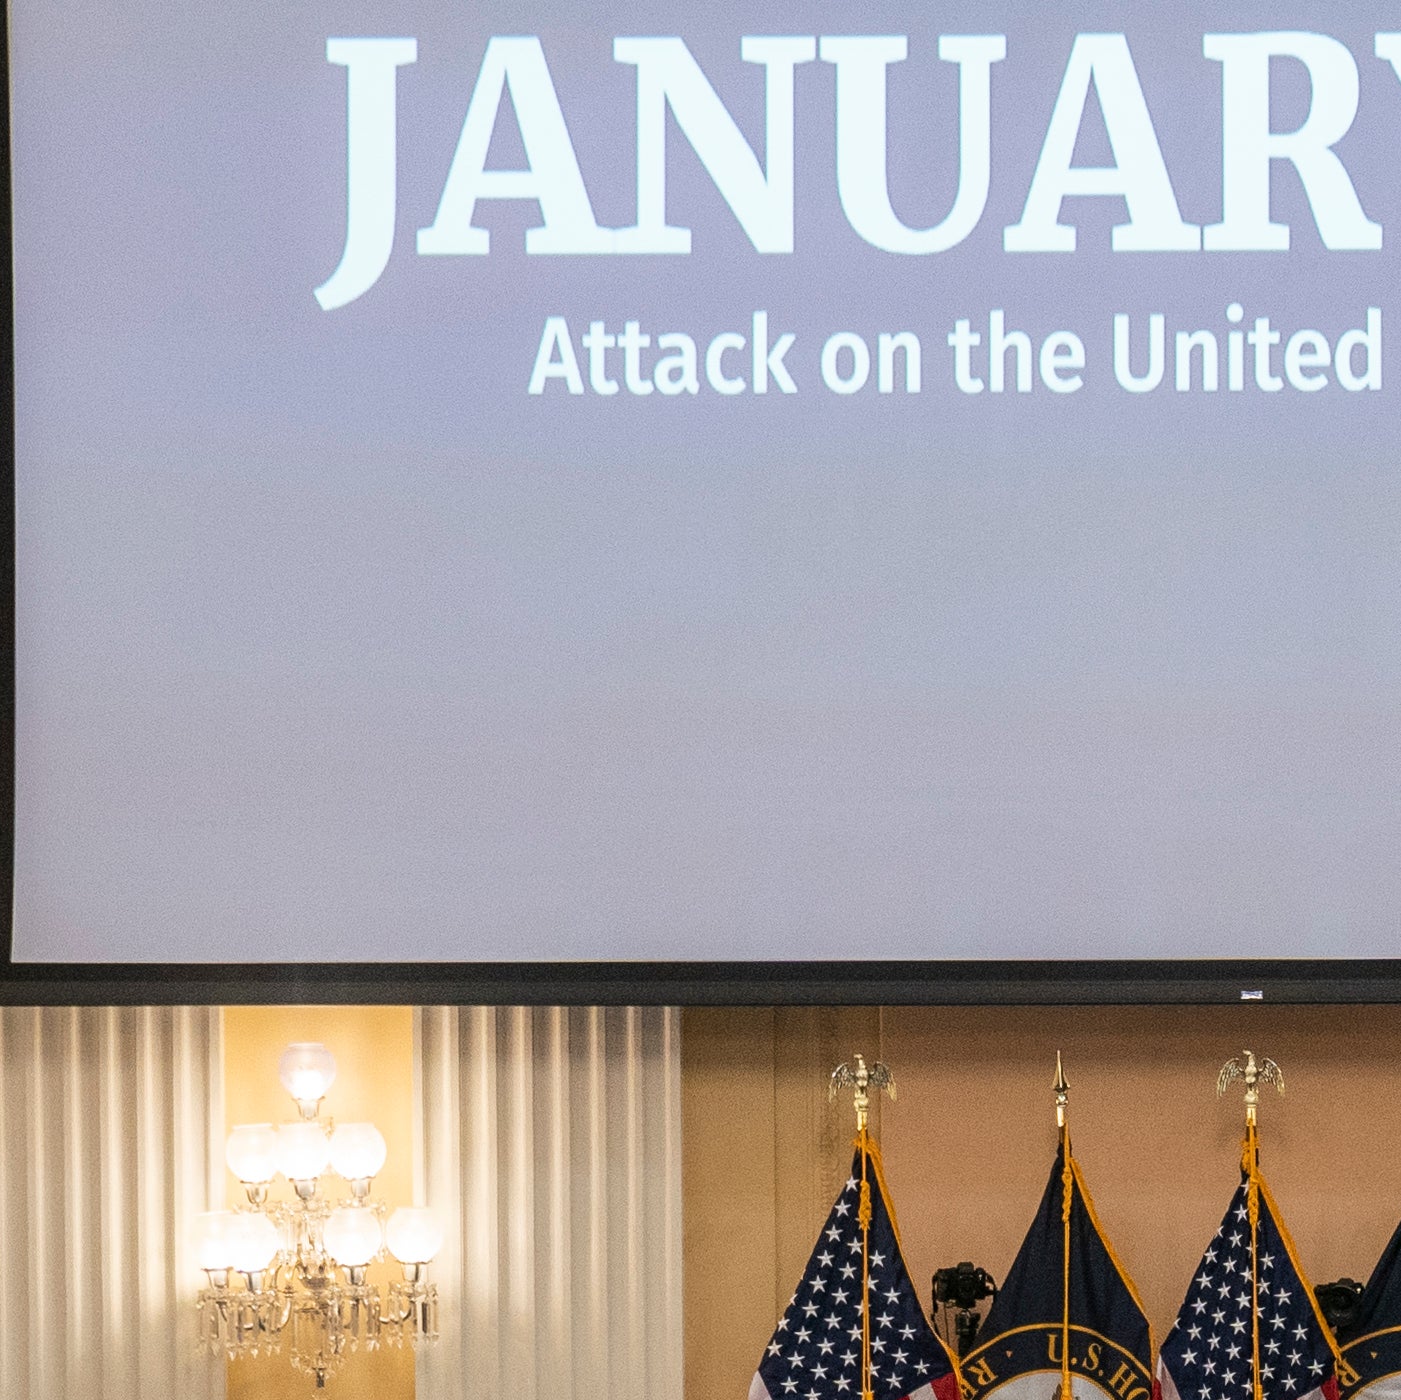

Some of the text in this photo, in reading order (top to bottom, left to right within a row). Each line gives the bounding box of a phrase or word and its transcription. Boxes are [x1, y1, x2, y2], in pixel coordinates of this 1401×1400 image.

[527, 309, 798, 396] Attack
[820, 331, 922, 395] on
[947, 308, 1086, 395] the
[1113, 302, 1382, 394] United
[1047, 1334, 1104, 1377] U.S.
